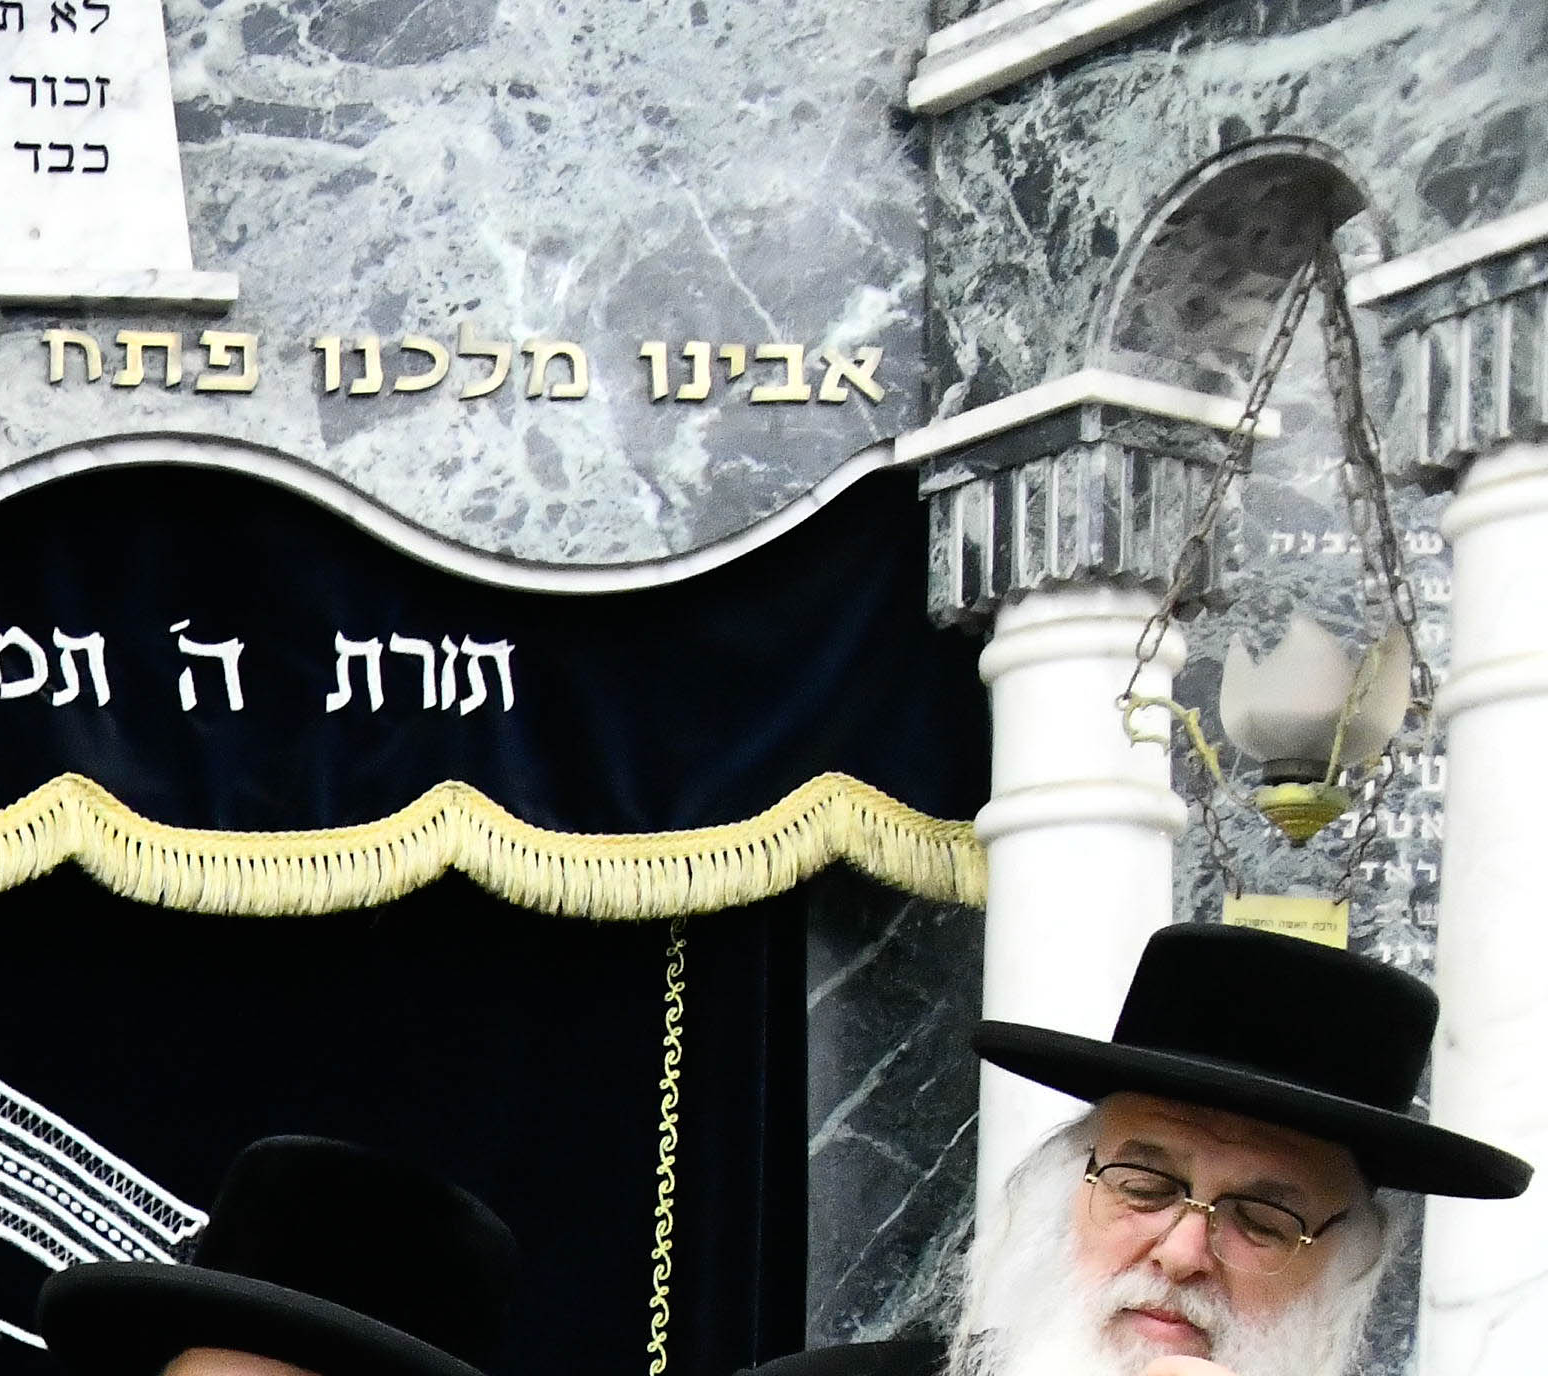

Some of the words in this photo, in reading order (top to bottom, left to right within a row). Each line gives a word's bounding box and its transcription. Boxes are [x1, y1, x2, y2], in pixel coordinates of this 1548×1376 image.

[50, 0, 110, 33] לא
[9, 73, 111, 108] זכור
[14, 140, 109, 173] כבד
[43, 327, 259, 392] פתח
[311, 322, 588, 400] מלכנו
[640, 337, 885, 404] אבינו
[325, 631, 516, 717] תורת
